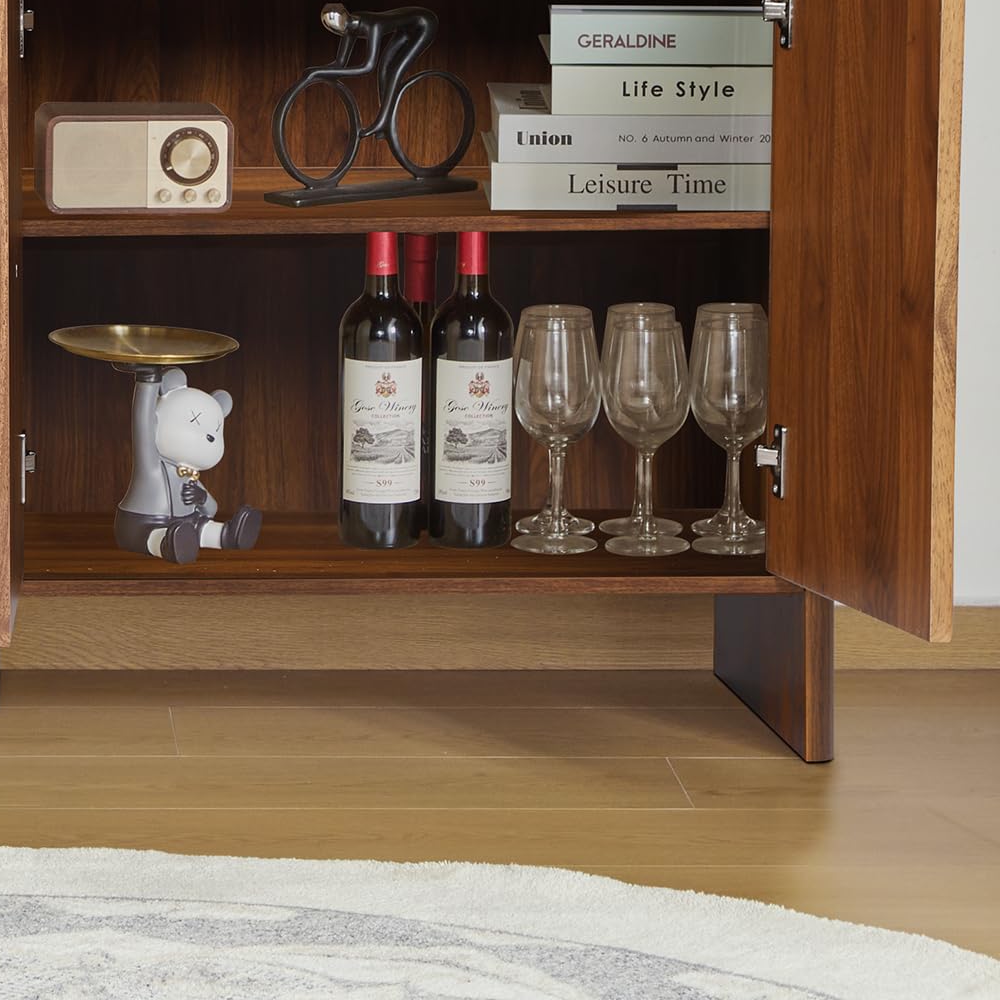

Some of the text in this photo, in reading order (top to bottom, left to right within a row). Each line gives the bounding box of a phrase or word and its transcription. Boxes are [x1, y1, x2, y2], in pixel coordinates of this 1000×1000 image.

[577, 34, 676, 48] GERALDINE
[622, 81, 735, 101] Life Style
[517, 131, 572, 146] Union
[618, 135, 636, 143] NO.
[642, 134, 648, 143] 6
[653, 135, 692, 143] Autumn
[695, 134, 714, 143] and
[720, 135, 754, 143] Winter
[568, 174, 727, 194] Leisure Time
[376, 479, 393, 487] S99
[469, 479, 486, 487] S99
